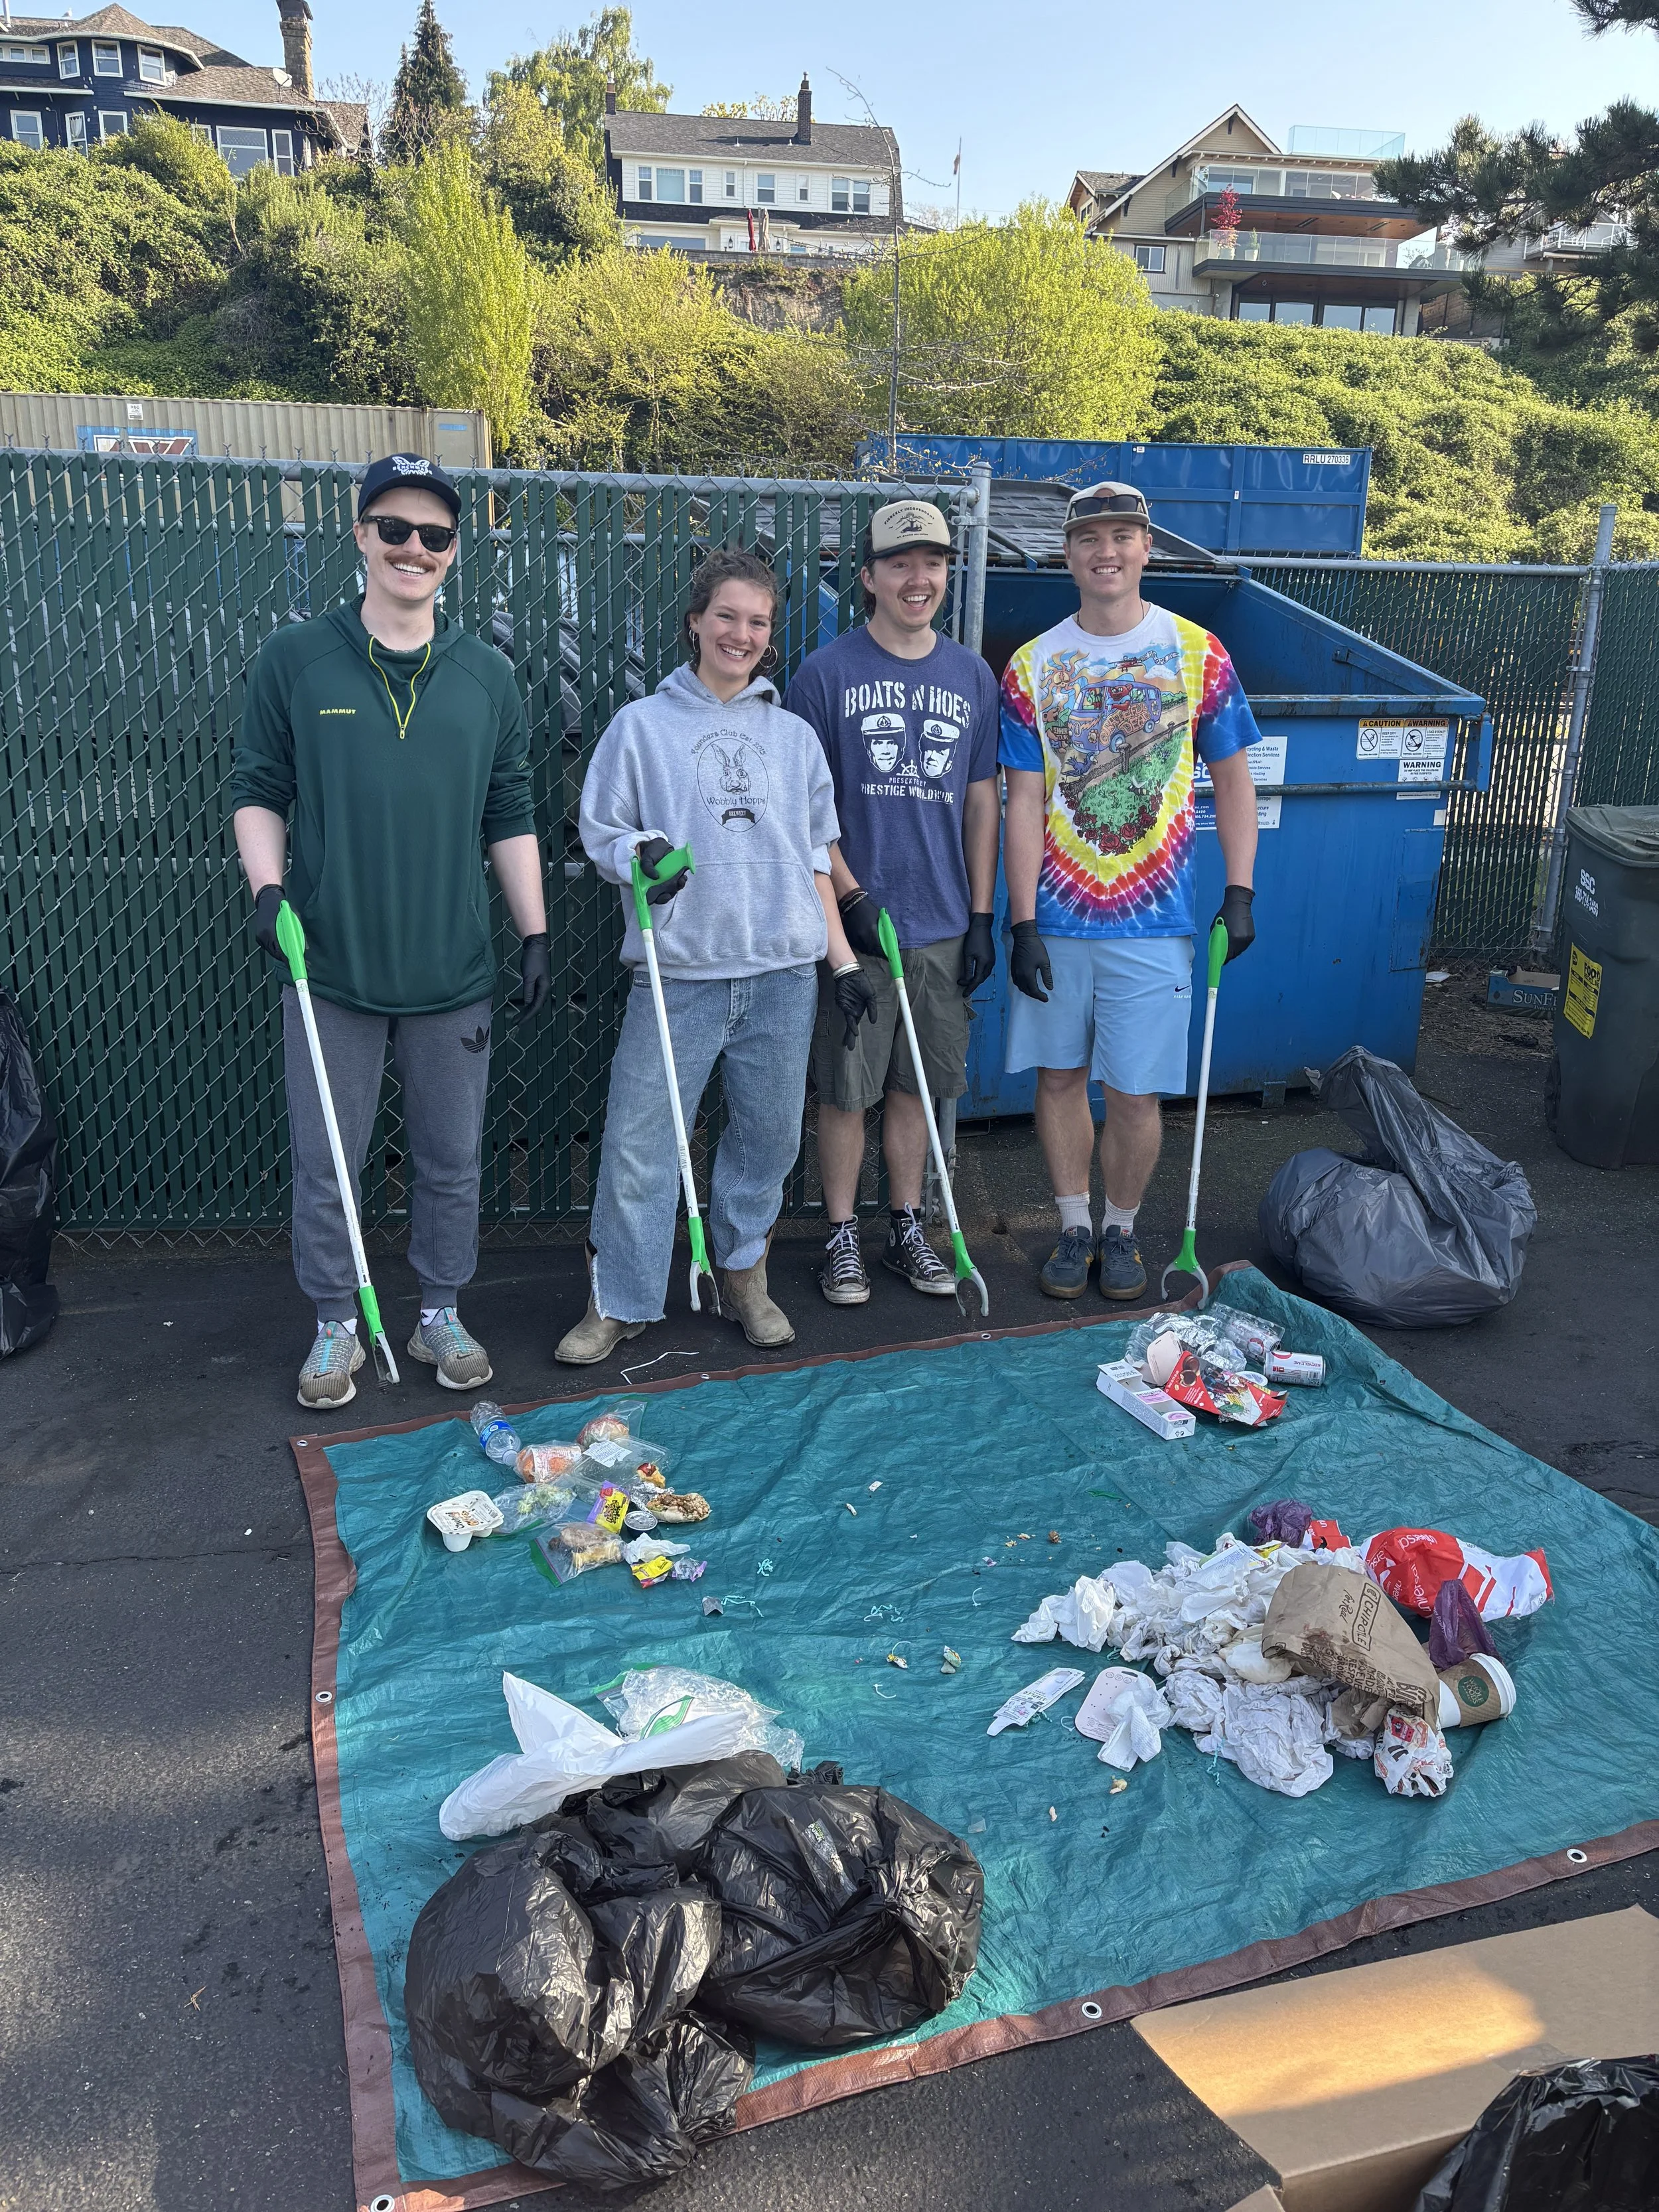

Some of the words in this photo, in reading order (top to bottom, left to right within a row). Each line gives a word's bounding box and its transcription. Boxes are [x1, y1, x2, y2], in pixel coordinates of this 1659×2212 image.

[1304, 455, 1326, 463] RRLU
[1327, 455, 1349, 464] 270336
[845, 680, 906, 718] BOATS
[929, 686, 972, 729] HOES
[691, 731, 719, 755] Founders
[706, 796, 737, 807] Wobbly
[861, 783, 905, 796] PRESTIGE
[1580, 869, 1595, 895] SSC
[1358, 1600, 1374, 1647] CHIPOTLE
[1345, 1657, 1357, 1685] RESPO
[1464, 1681, 1479, 1704] FOODS
[1469, 1678, 1484, 1703] WHOLE
[808, 1823, 822, 1843] PUNCH
